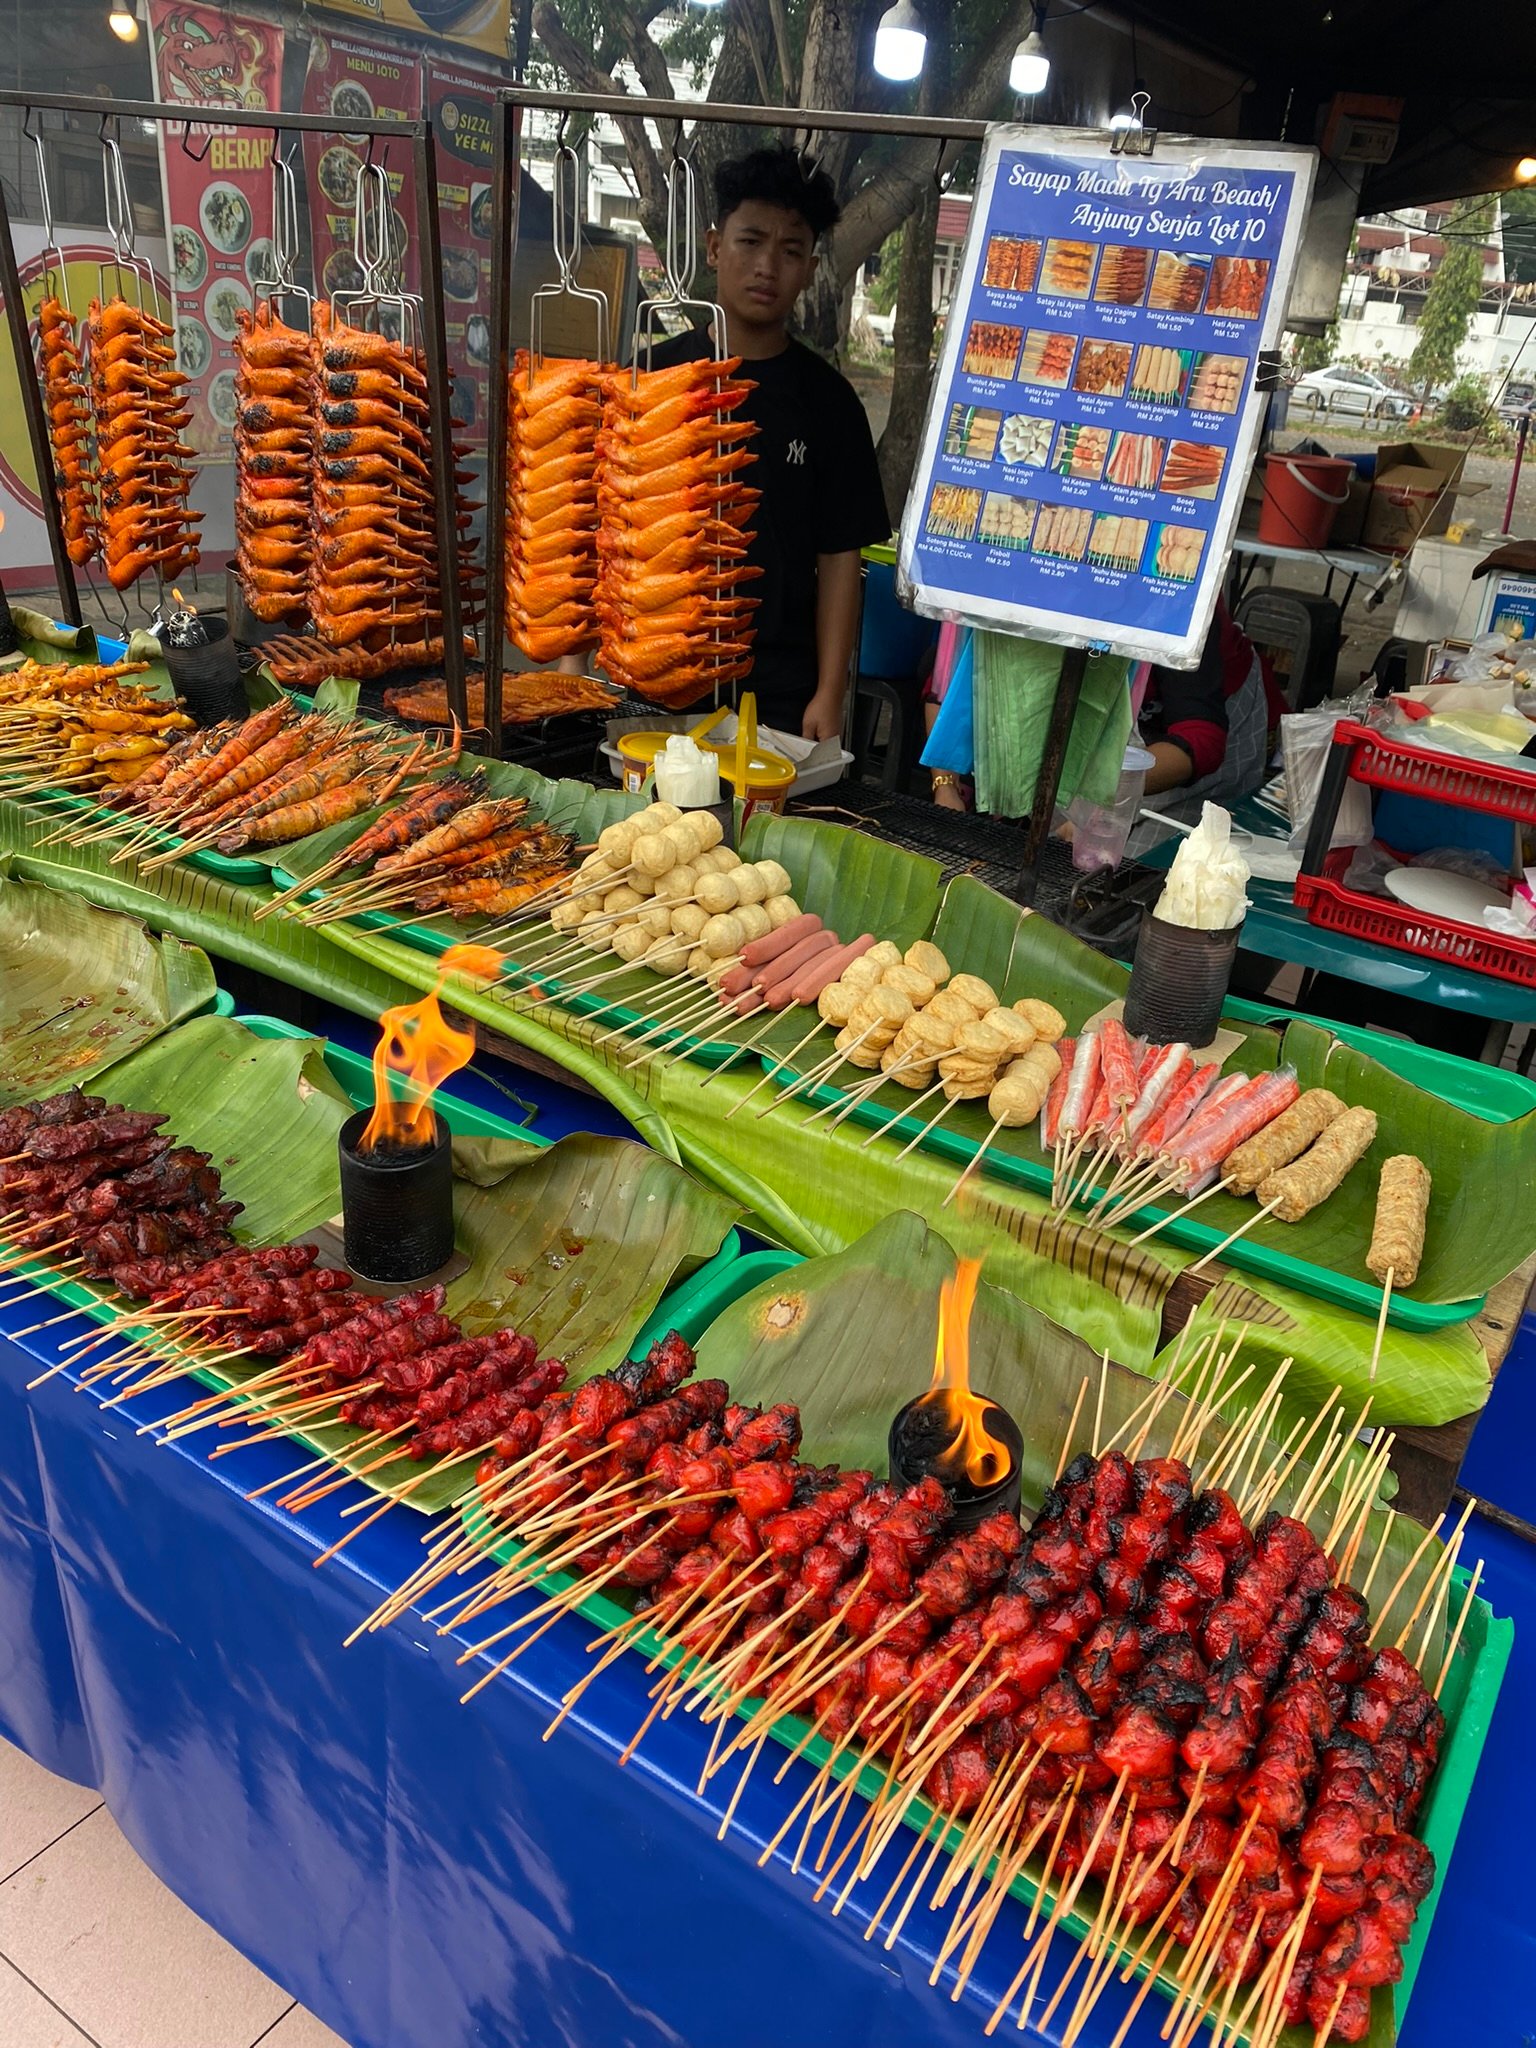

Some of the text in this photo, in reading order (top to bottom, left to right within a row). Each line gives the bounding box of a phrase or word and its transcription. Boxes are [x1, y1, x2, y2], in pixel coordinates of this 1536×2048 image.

[347, 57, 400, 80] MENU SOTO
[460, 113, 494, 135] SIZZL
[455, 132, 478, 150] YEE
[1008, 164, 1071, 196] Sayap
[1075, 170, 1134, 196] Madu
[1139, 176, 1164, 205] Tg
[1165, 178, 1206, 202] Aru
[1070, 204, 1266, 245] Anjung Senja Lot 10
[986, 290, 1024, 301] Sayap Madu
[1036, 297, 1056, 307] Satay
[1066, 301, 1085, 310] Ayam
[1046, 308, 1057, 316] RM
[1095, 306, 1137, 318] Satay Daging
[1102, 315, 1113, 323] RM
[1147, 312, 1194, 325] Satay Kambing
[1212, 320, 1245, 330] Hati Ayam
[1227, 331, 1239, 339] 1.20
[988, 380, 1006, 389] Ayam
[972, 386, 997, 396] RM 1.50
[1024, 387, 1060, 398] Satay Ayam
[1029, 396, 1053, 406] RM 1.20
[1096, 399, 1113, 407] Ayam
[1126, 401, 1139, 409] Fish
[1153, 406, 1178, 417] panjang
[1137, 412, 1163, 422] RM 2.50
[1200, 413, 1224, 422] Lobster
[786, 439, 807, 465] NY
[941, 454, 960, 464] Tauhu
[961, 458, 973, 466] Fish
[963, 467, 976, 475] 2.00
[1002, 466, 1034, 477] Nasi Impit
[1016, 477, 1028, 485] 1.20
[1071, 479, 1091, 488] Ketam
[1073, 488, 1088, 496] 2.00
[1108, 485, 1129, 494] Ketam
[1130, 490, 1156, 500] panjang
[1125, 497, 1138, 505] 1.50
[1176, 497, 1195, 506] Sosej
[1171, 505, 1196, 515] RM 1.20
[949, 541, 967, 549] Bakar
[950, 549, 973, 559] CUCUK
[985, 556, 1011, 567] RM 2.50
[1030, 557, 1078, 572] Fish kek gulung
[1091, 566, 1128, 579] Tauhu biasa
[1106, 578, 1120, 586] 2.00
[1142, 576, 1187, 590] Fish kek sayur
